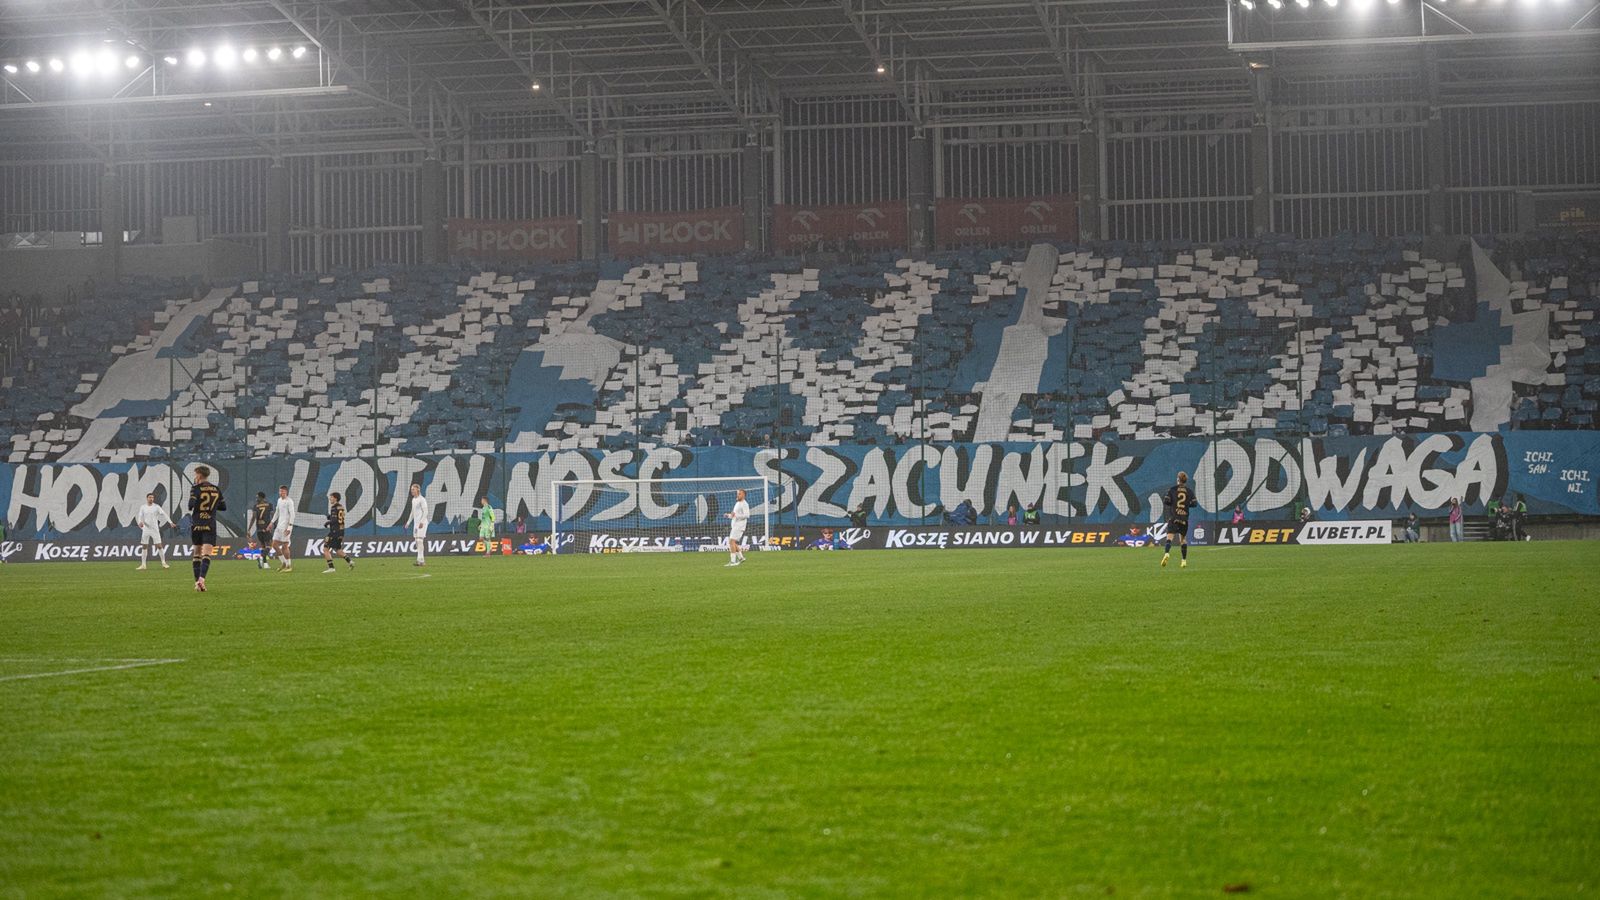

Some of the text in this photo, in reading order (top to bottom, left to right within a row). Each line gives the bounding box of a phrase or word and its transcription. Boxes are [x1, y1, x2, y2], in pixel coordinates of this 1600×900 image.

[643, 219, 733, 244] PŁOCK
[954, 227, 991, 237] ORLEN
[1020, 224, 1057, 234] ORLEN
[853, 231, 889, 241] ORLEN
[1523, 451, 1554, 462] ICHI.
[1194, 433, 1499, 513] ODWAGA
[1528, 464, 1551, 474] SAN.
[1560, 470, 1591, 482] ICHI.
[199, 492, 219, 512] 27
[1176, 492, 1187, 508] 2
[259, 507, 266, 518] 7
[885, 529, 949, 549] KOSZĘ
[953, 531, 1015, 545] SIANO
[1020, 531, 1040, 544] W
[1217, 527, 1295, 544] LVBET
[1306, 526, 1386, 540] LVBET.PL
[34, 543, 90, 561] KOSZĘ
[172, 544, 231, 557] LVET
[427, 540, 446, 553] W
[450, 540, 503, 553] LVBE
